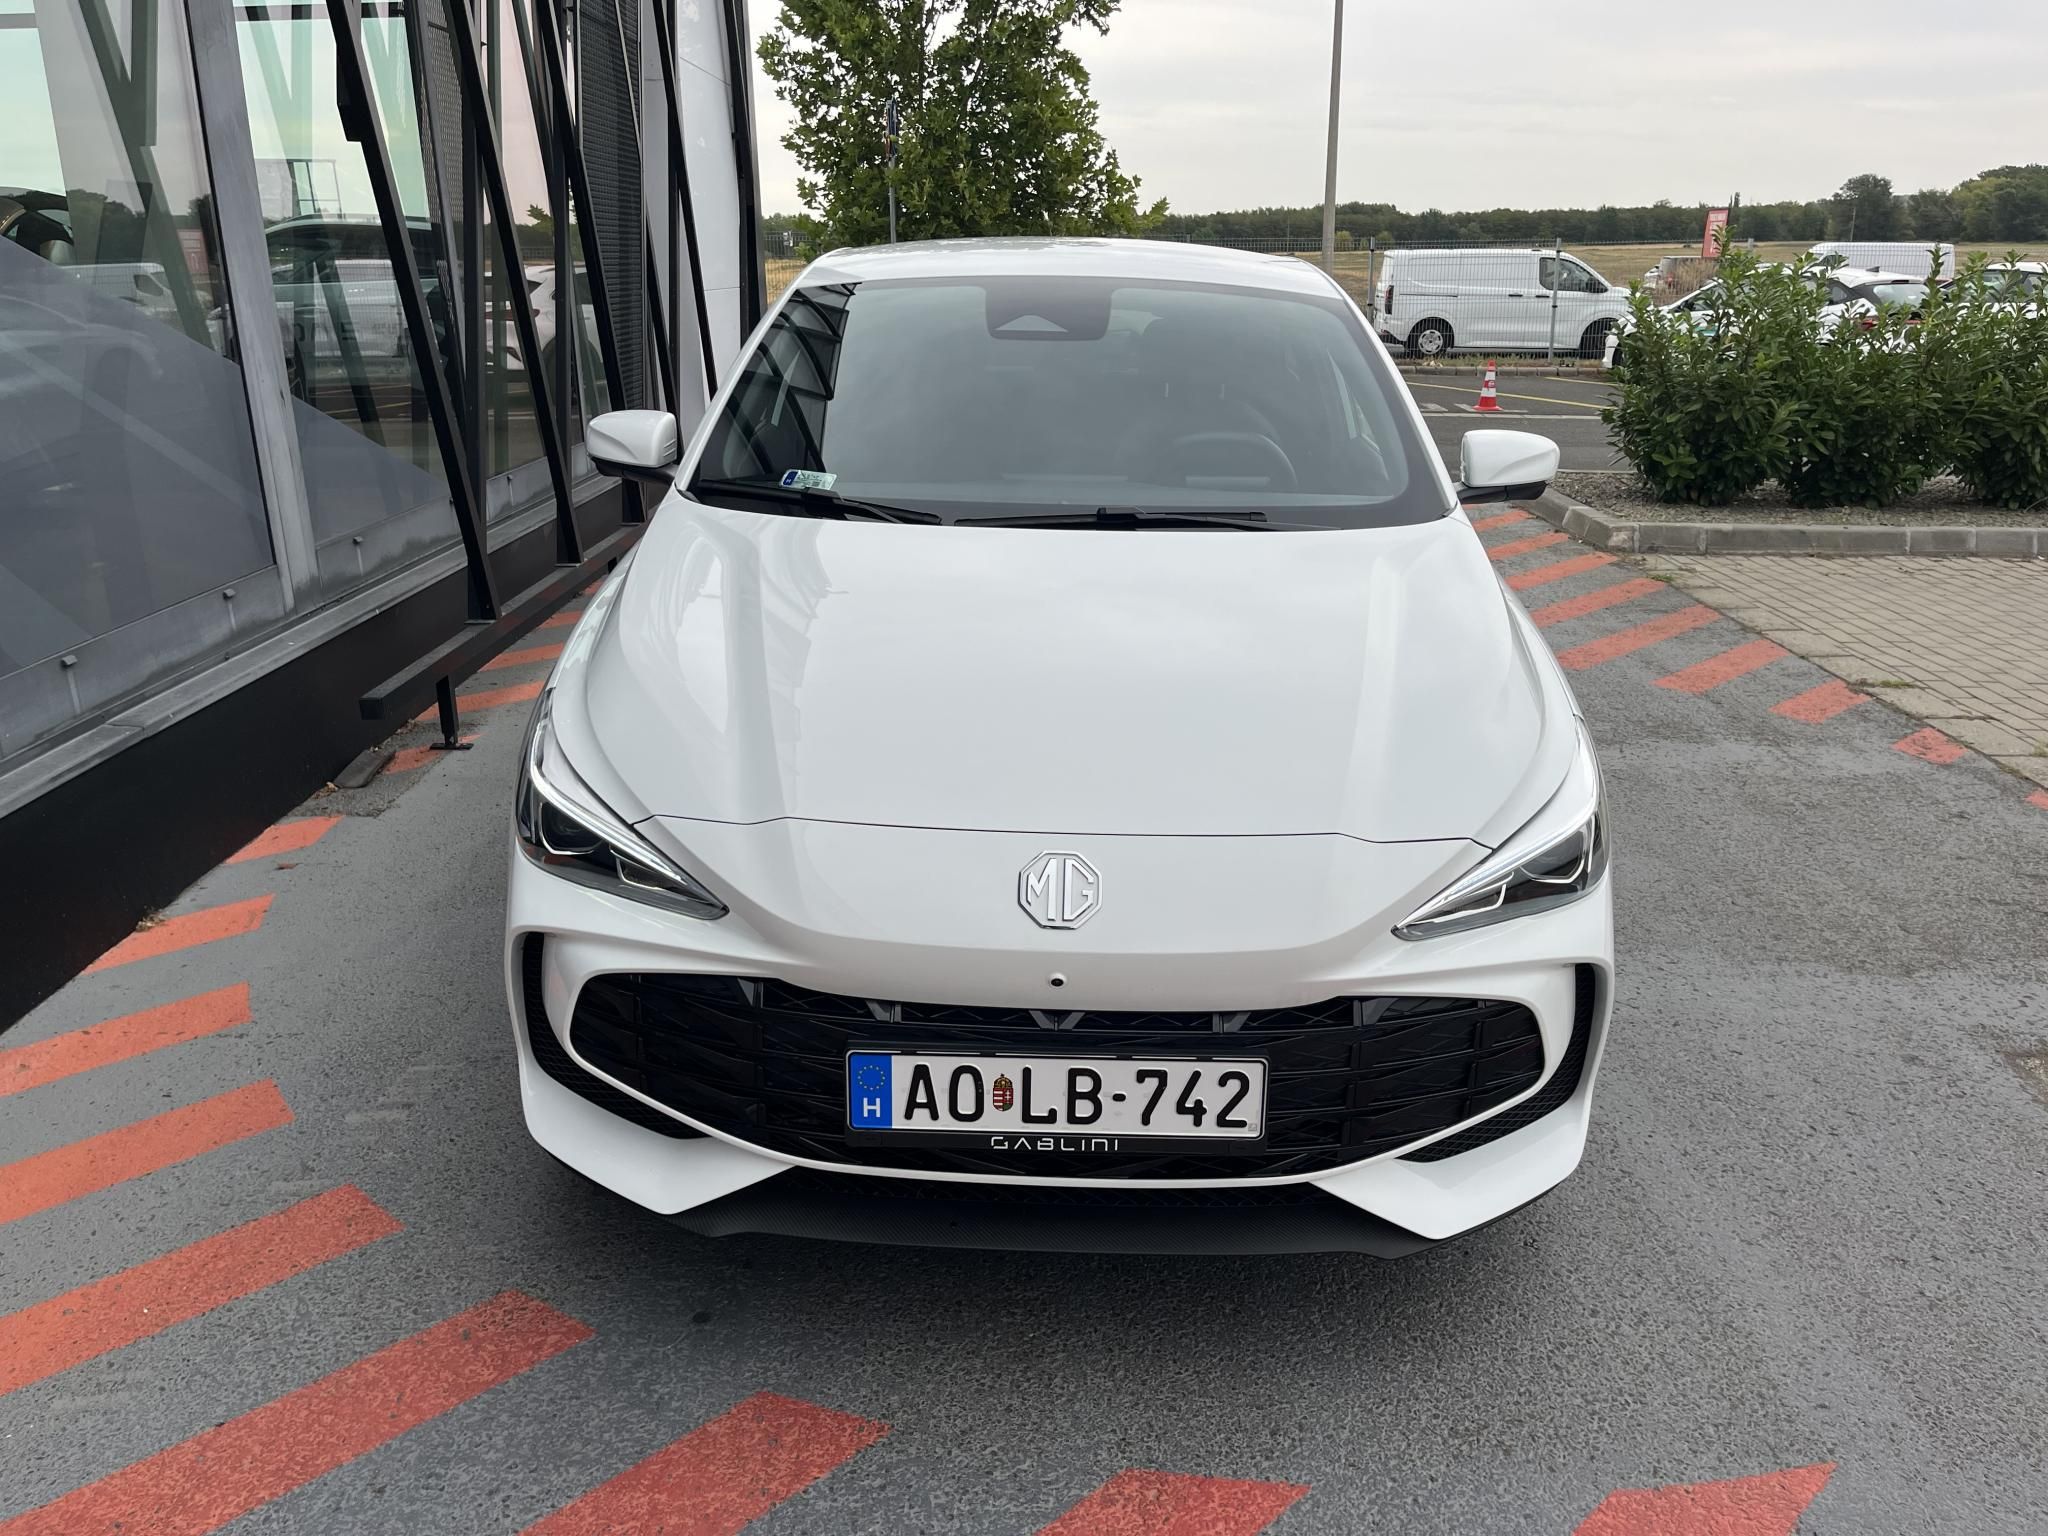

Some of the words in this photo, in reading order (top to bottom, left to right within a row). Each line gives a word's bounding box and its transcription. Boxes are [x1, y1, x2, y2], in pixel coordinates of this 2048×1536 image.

[1026, 857, 1094, 921] MG
[863, 1097, 881, 1118] H
[904, 1063, 985, 1122] AO
[991, 1136, 1118, 1151] GABLINI
